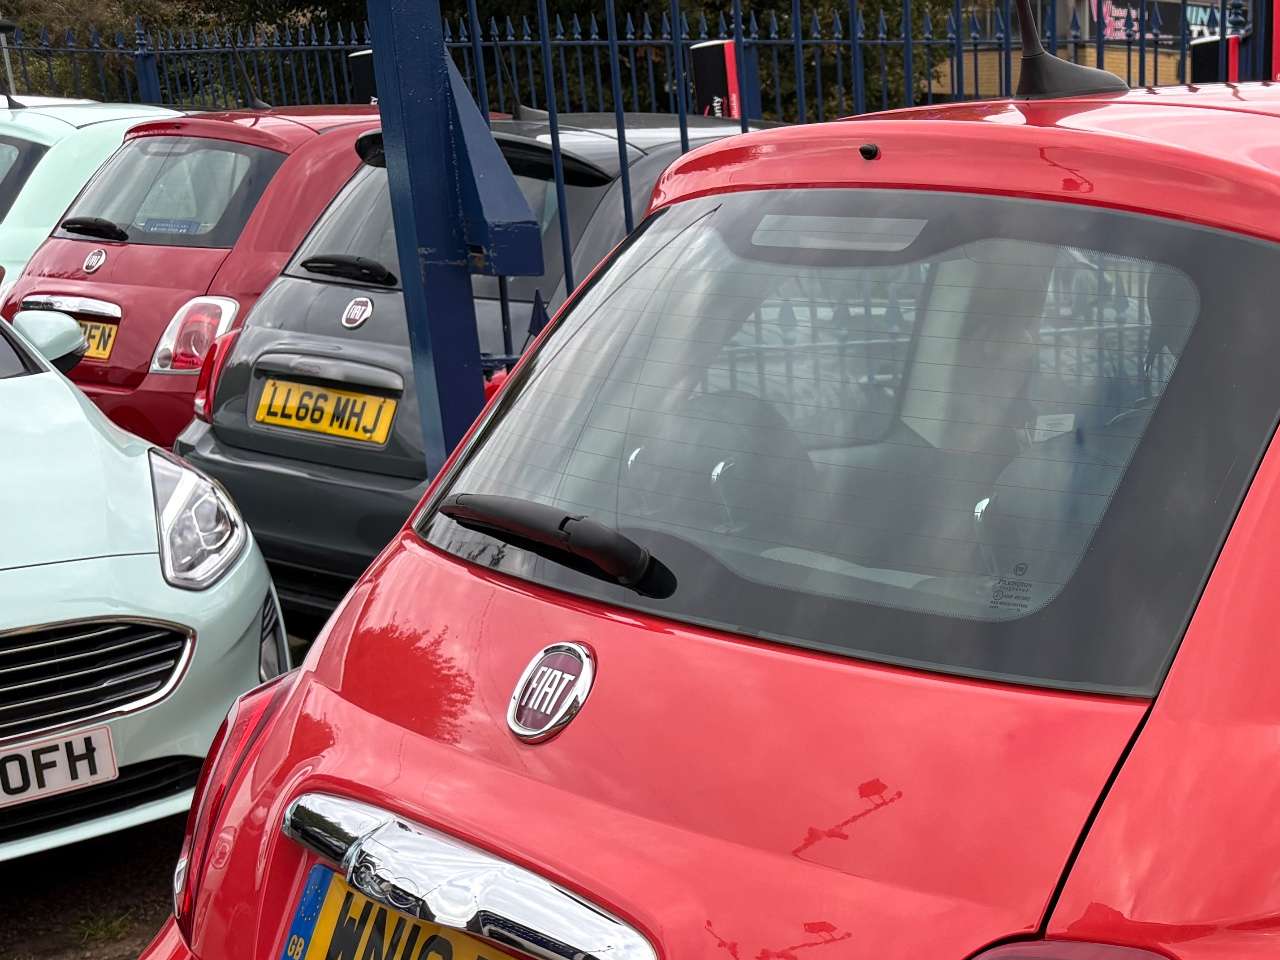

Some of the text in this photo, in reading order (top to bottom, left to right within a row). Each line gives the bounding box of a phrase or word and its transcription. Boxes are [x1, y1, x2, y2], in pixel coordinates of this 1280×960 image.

[347, 304, 367, 320] FIAT
[266, 386, 386, 434] LL66 MHJ
[521, 665, 576, 715] FIAT
[287, 934, 305, 960] GB
